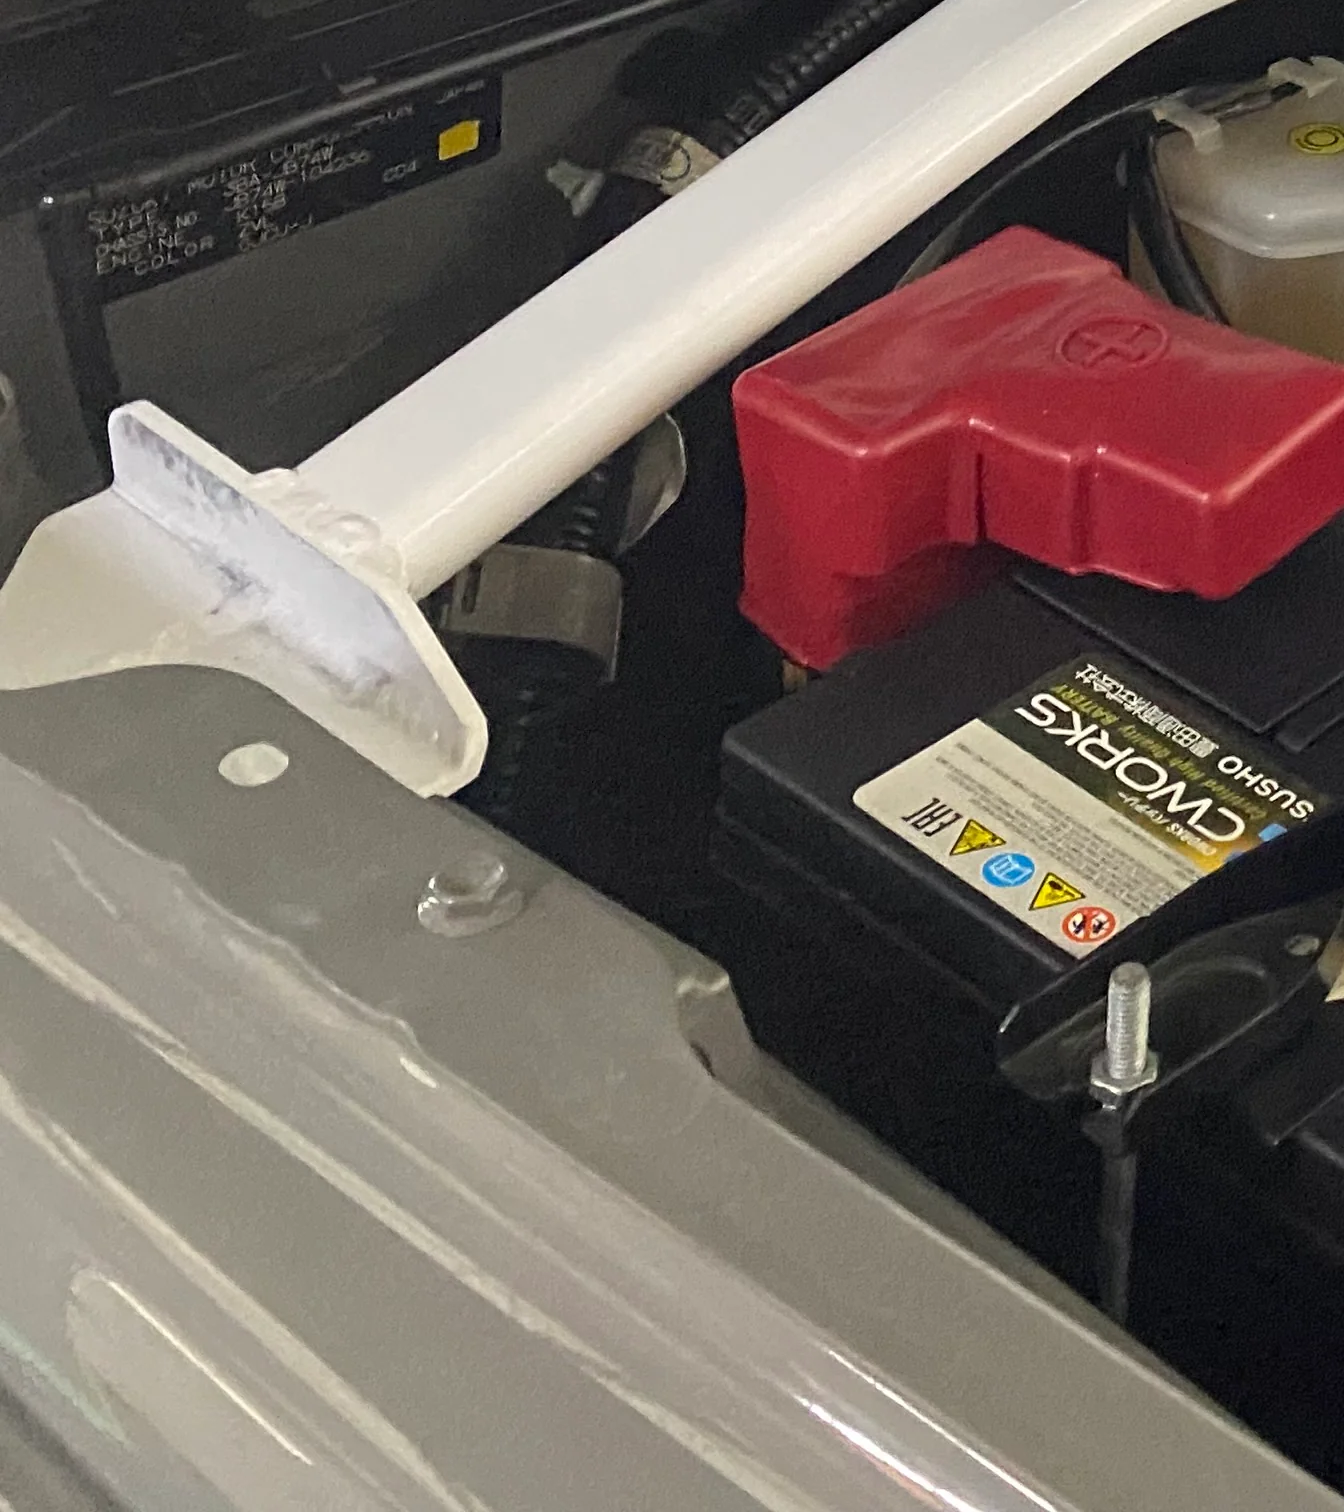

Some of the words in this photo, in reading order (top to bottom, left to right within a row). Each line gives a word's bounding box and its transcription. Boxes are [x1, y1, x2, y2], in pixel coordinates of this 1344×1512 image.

[94, 209, 156, 241] TYPE
[96, 231, 184, 274] ENGINE
[134, 235, 213, 275] COLOR
[1016, 693, 1251, 844] CWORKS
